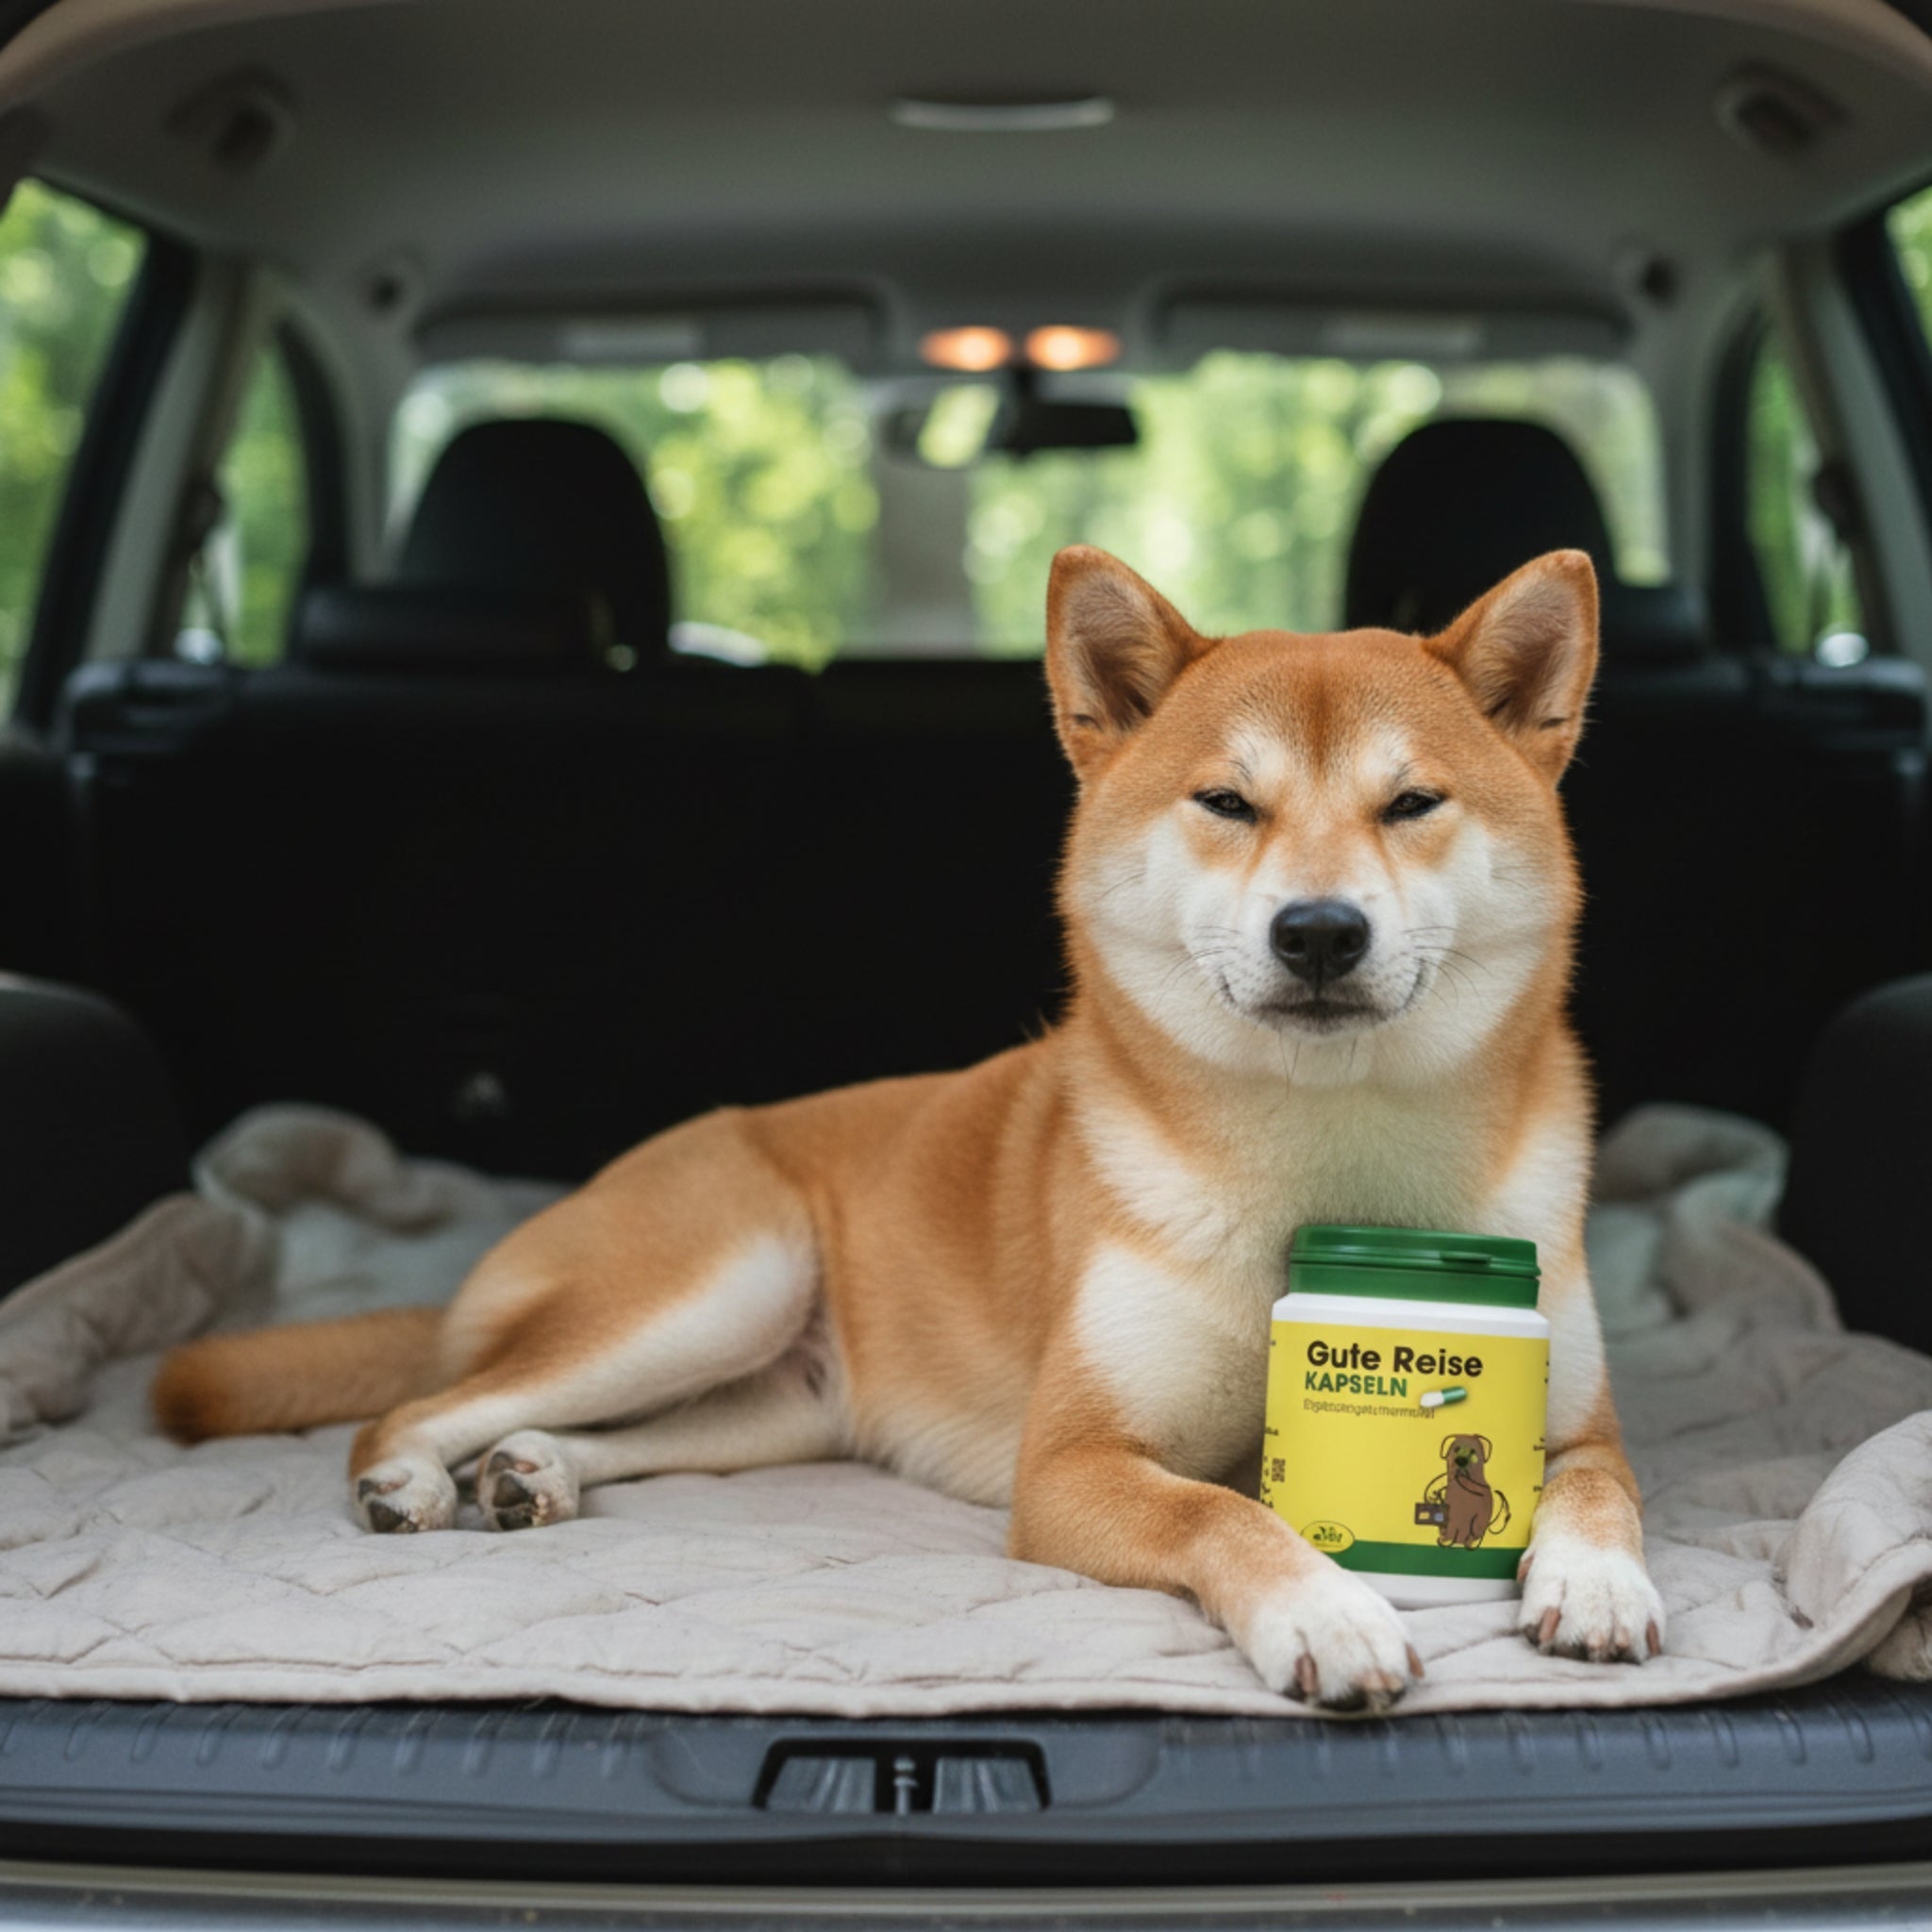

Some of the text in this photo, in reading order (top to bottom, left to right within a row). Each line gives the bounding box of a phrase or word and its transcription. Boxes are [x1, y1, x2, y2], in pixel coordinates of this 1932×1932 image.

[1307, 1341, 1483, 1376] Gute Reise
[1305, 1371, 1407, 1397] KAPSELN
